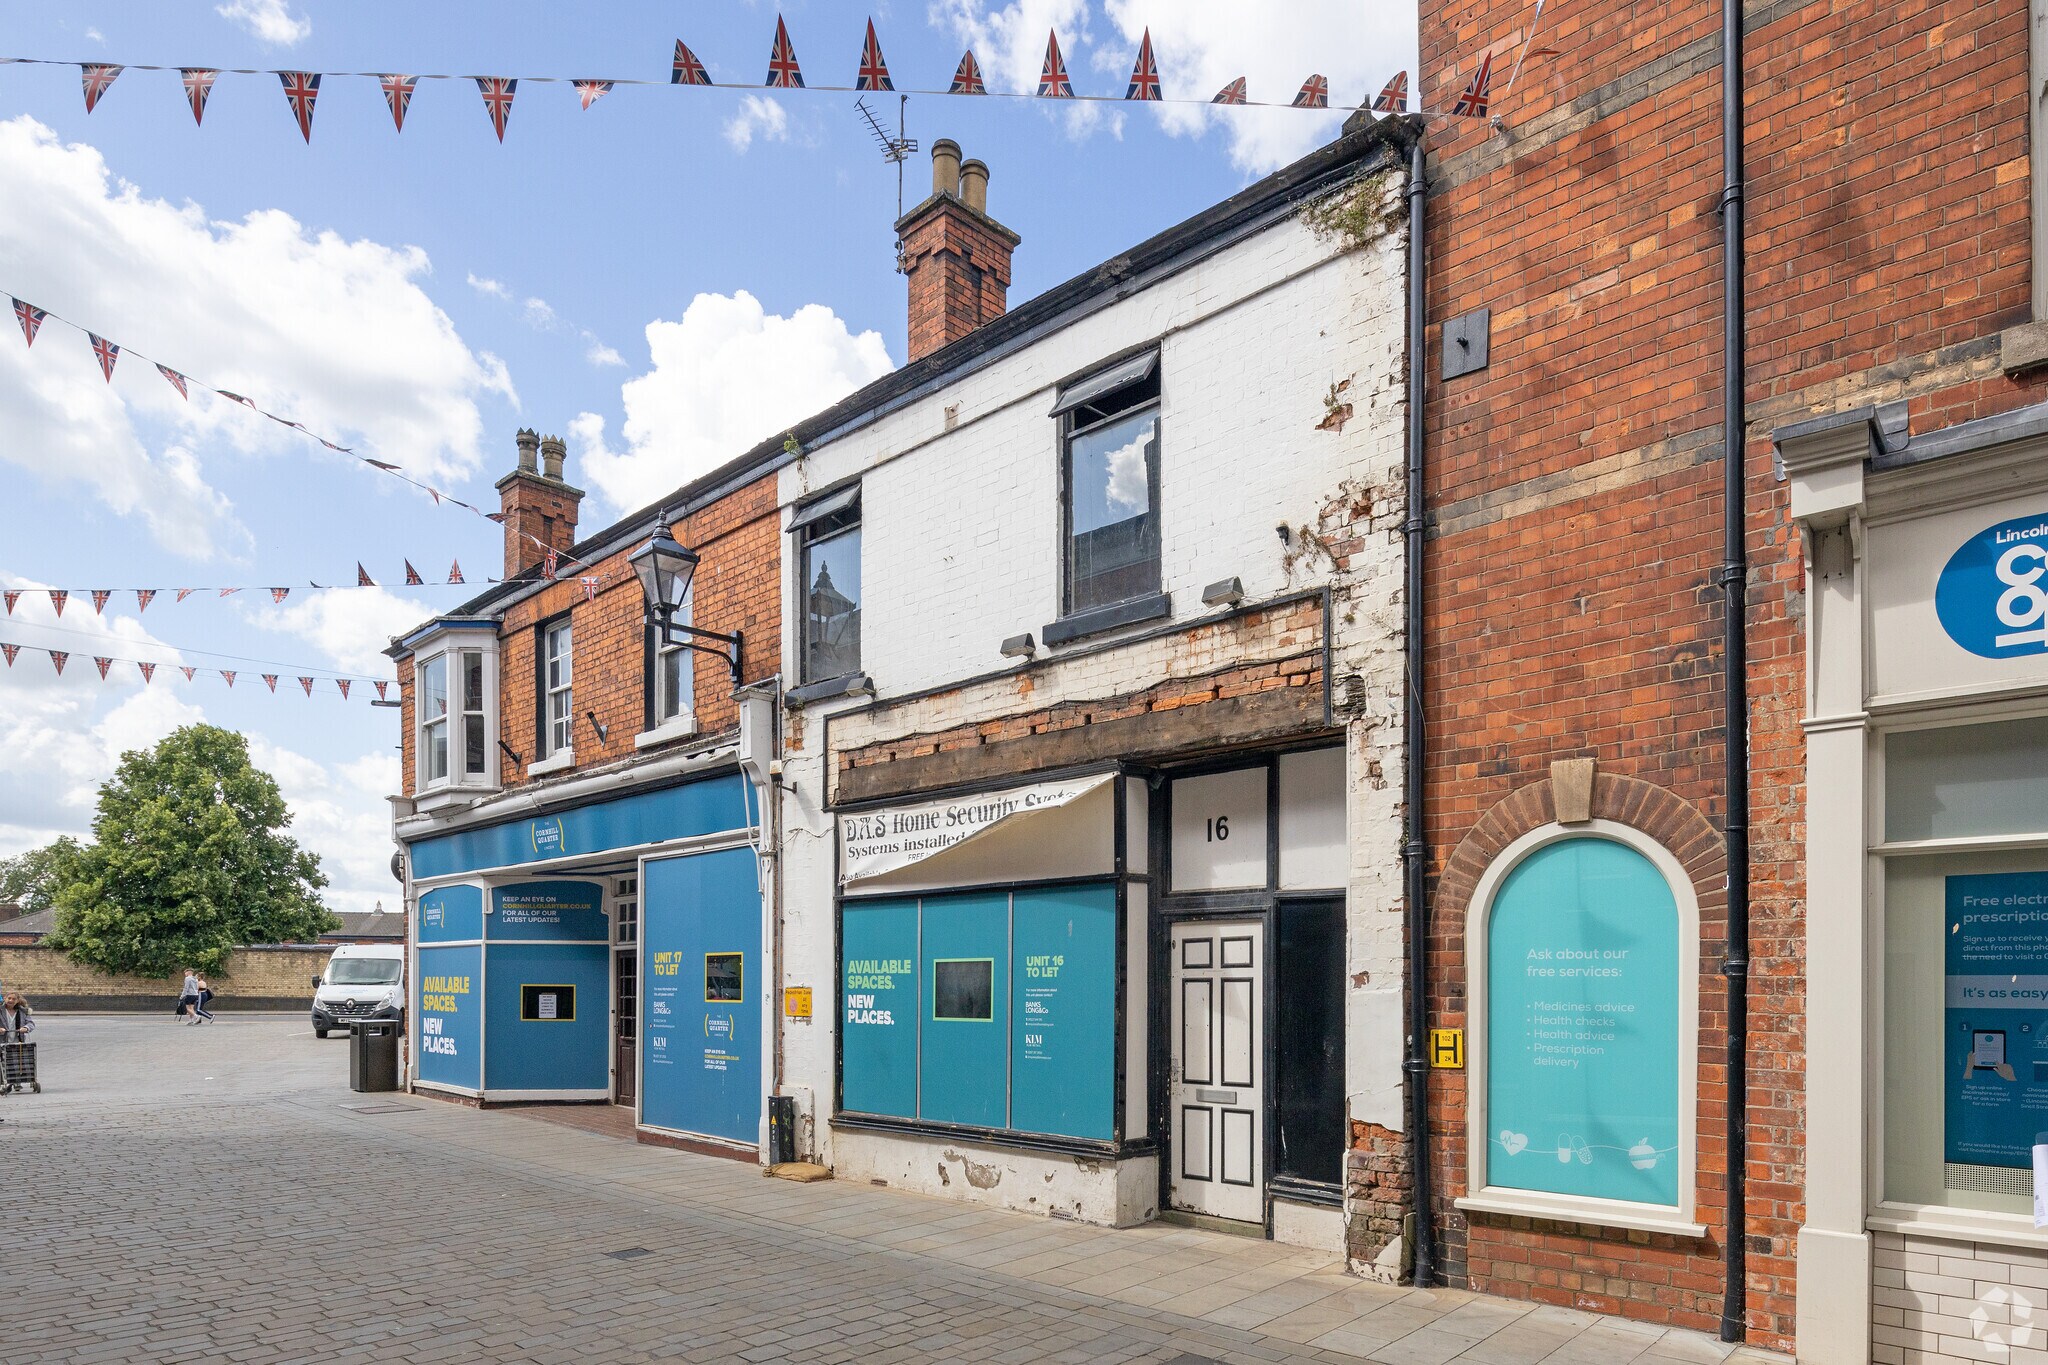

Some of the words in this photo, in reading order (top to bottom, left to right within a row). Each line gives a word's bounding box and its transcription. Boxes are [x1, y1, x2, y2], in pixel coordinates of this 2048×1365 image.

[893, 808, 940, 834] Home
[945, 797, 1018, 828] Security
[535, 827, 559, 837] CORNHILL
[1207, 816, 1229, 842] 16
[537, 834, 559, 844] QUARTER
[848, 839, 900, 860] Systems
[904, 831, 966, 853] installed
[1963, 895, 2000, 907] Free
[1963, 935, 1982, 945] Sign
[1526, 948, 1553, 960] Ask
[1556, 948, 1600, 960] about
[1603, 949, 1629, 959] our
[1962, 944, 1989, 952] direct
[654, 951, 672, 963] UNIT
[673, 951, 683, 963] 17
[1026, 955, 1050, 967] UNIT
[1052, 955, 1064, 966] 16
[654, 964, 665, 976] TO
[666, 963, 679, 976] LET
[848, 959, 912, 974] AVAILABLE
[1026, 967, 1040, 978] TO
[1041, 966, 1059, 978] LET
[1527, 965, 1555, 977] free
[1559, 965, 1622, 977] services:
[423, 976, 470, 994] AVAILABLE
[848, 975, 896, 990] SPACES.
[848, 994, 875, 1009] NEW
[1989, 990, 2007, 998] as
[2011, 990, 2048, 1001] easy
[423, 994, 458, 1013] SPACES.
[1534, 1001, 1592, 1012] Medicines
[1594, 1002, 1635, 1012] advice
[848, 1009, 895, 1025] PLACES.
[1534, 1015, 1572, 1026] Health
[1575, 1016, 1616, 1027] checks
[423, 1017, 443, 1035] NEW
[1962, 1023, 1967, 1031] 1
[1534, 1029, 1572, 1039] Health
[1575, 1030, 1615, 1041] advice
[423, 1035, 458, 1056] PLACES.
[1435, 1033, 1458, 1064] H
[1534, 1042, 1605, 1056] Prescription
[1533, 1056, 1579, 1069] delivery
